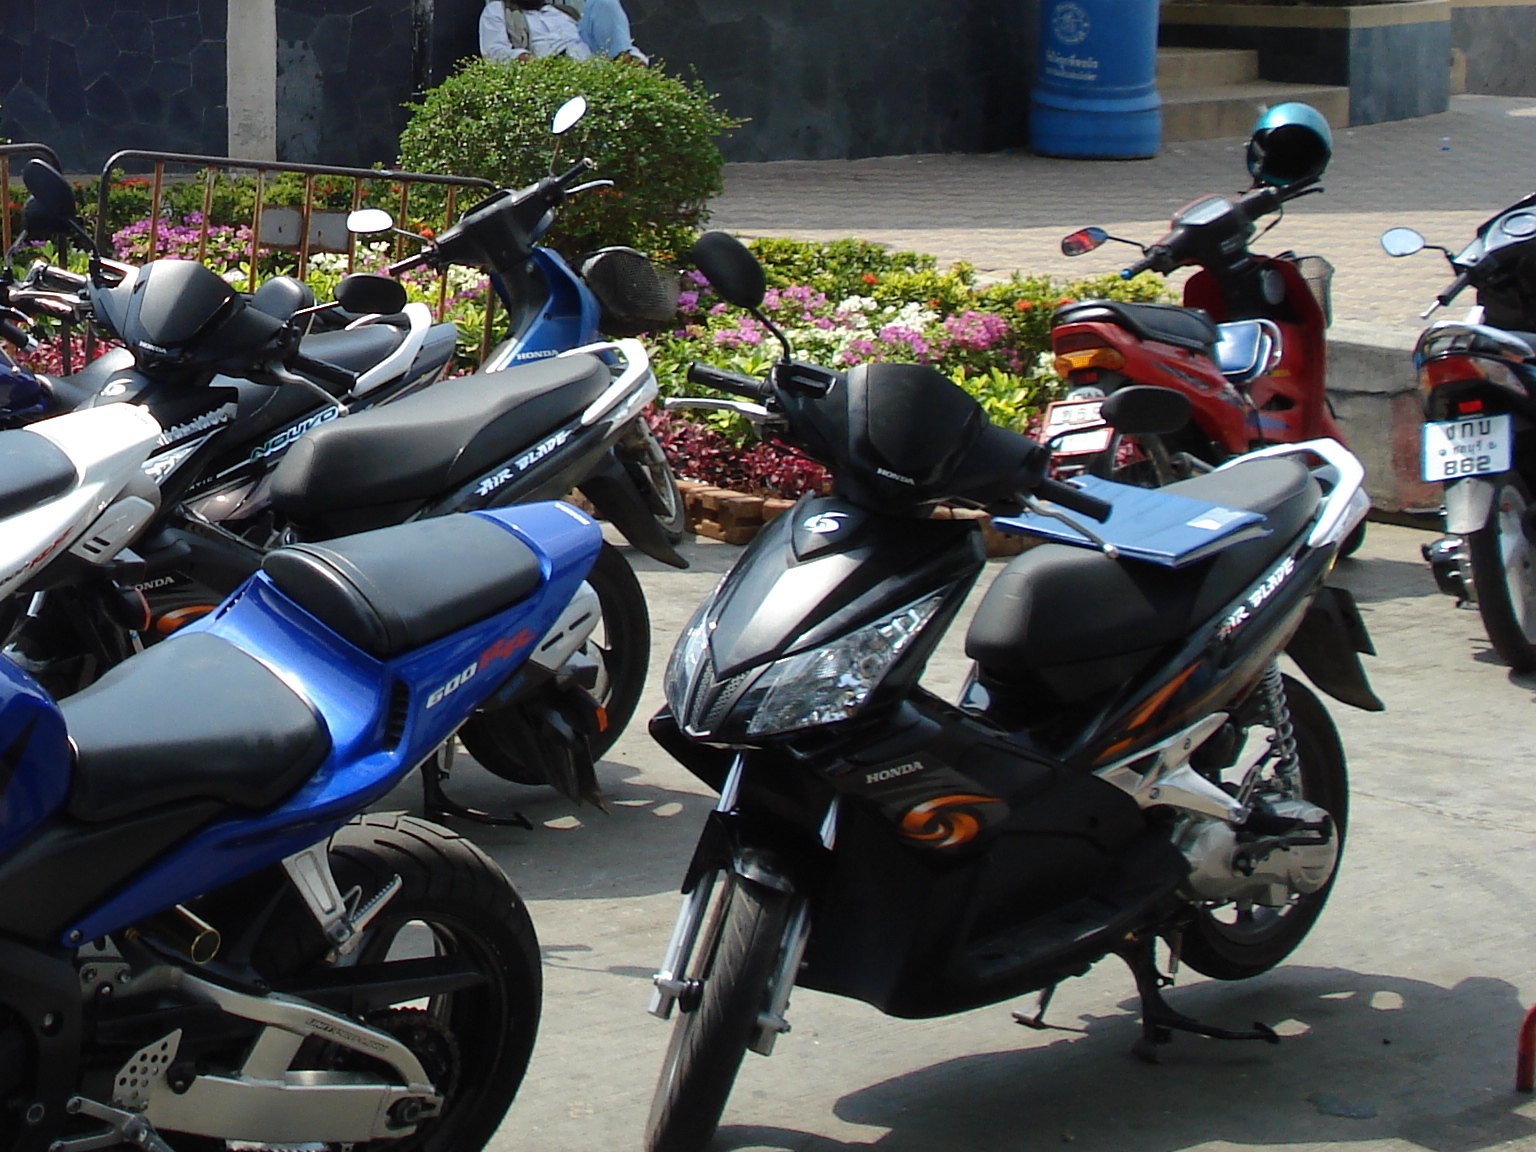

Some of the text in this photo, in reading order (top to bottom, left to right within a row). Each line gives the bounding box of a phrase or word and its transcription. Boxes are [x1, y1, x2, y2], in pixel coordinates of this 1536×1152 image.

[517, 349, 560, 361] HONDA
[250, 406, 339, 463] NOUVO
[474, 430, 574, 496] AIR BLADE
[1444, 455, 1491, 476] 862
[876, 467, 915, 485] HONDA
[136, 576, 175, 592] ONDA
[1248, 556, 1296, 608] BLADE
[865, 761, 924, 784] HONDA
